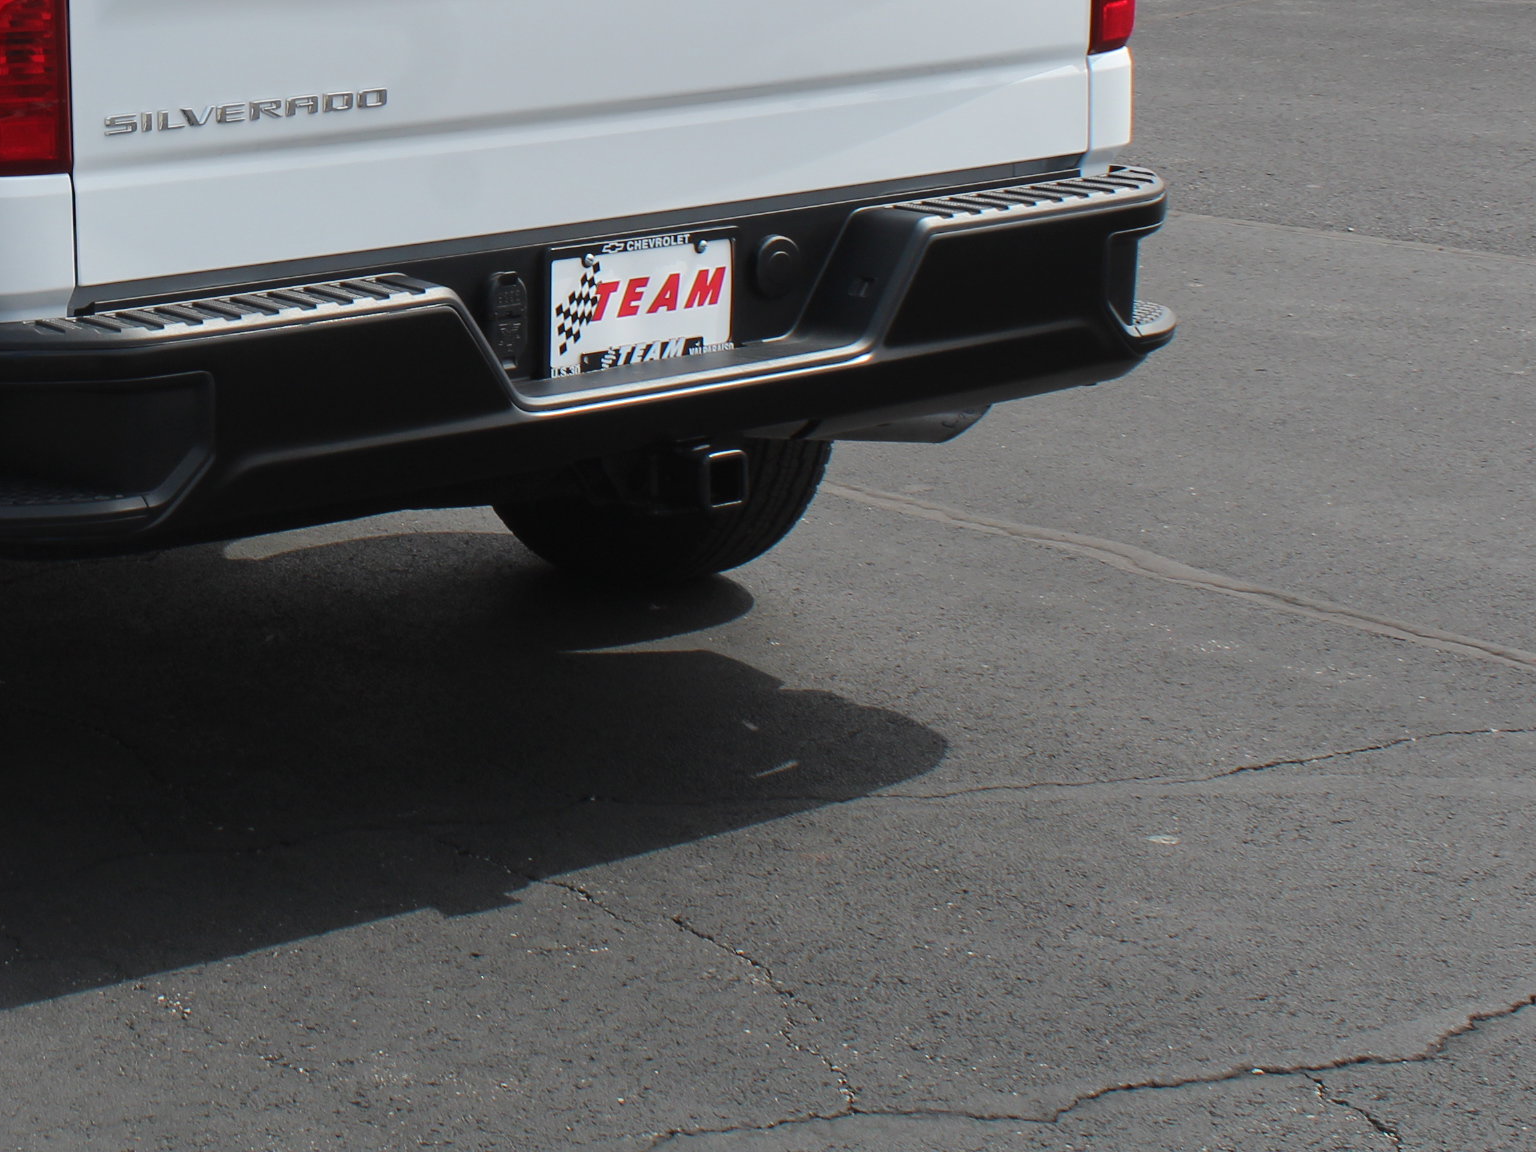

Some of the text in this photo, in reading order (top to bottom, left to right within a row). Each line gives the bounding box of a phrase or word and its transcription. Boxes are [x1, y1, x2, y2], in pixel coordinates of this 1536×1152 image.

[103, 87, 388, 137] SILVERADO
[626, 234, 691, 252] CHEVROLET
[591, 266, 727, 322] TEAM
[615, 337, 687, 366] TEAM
